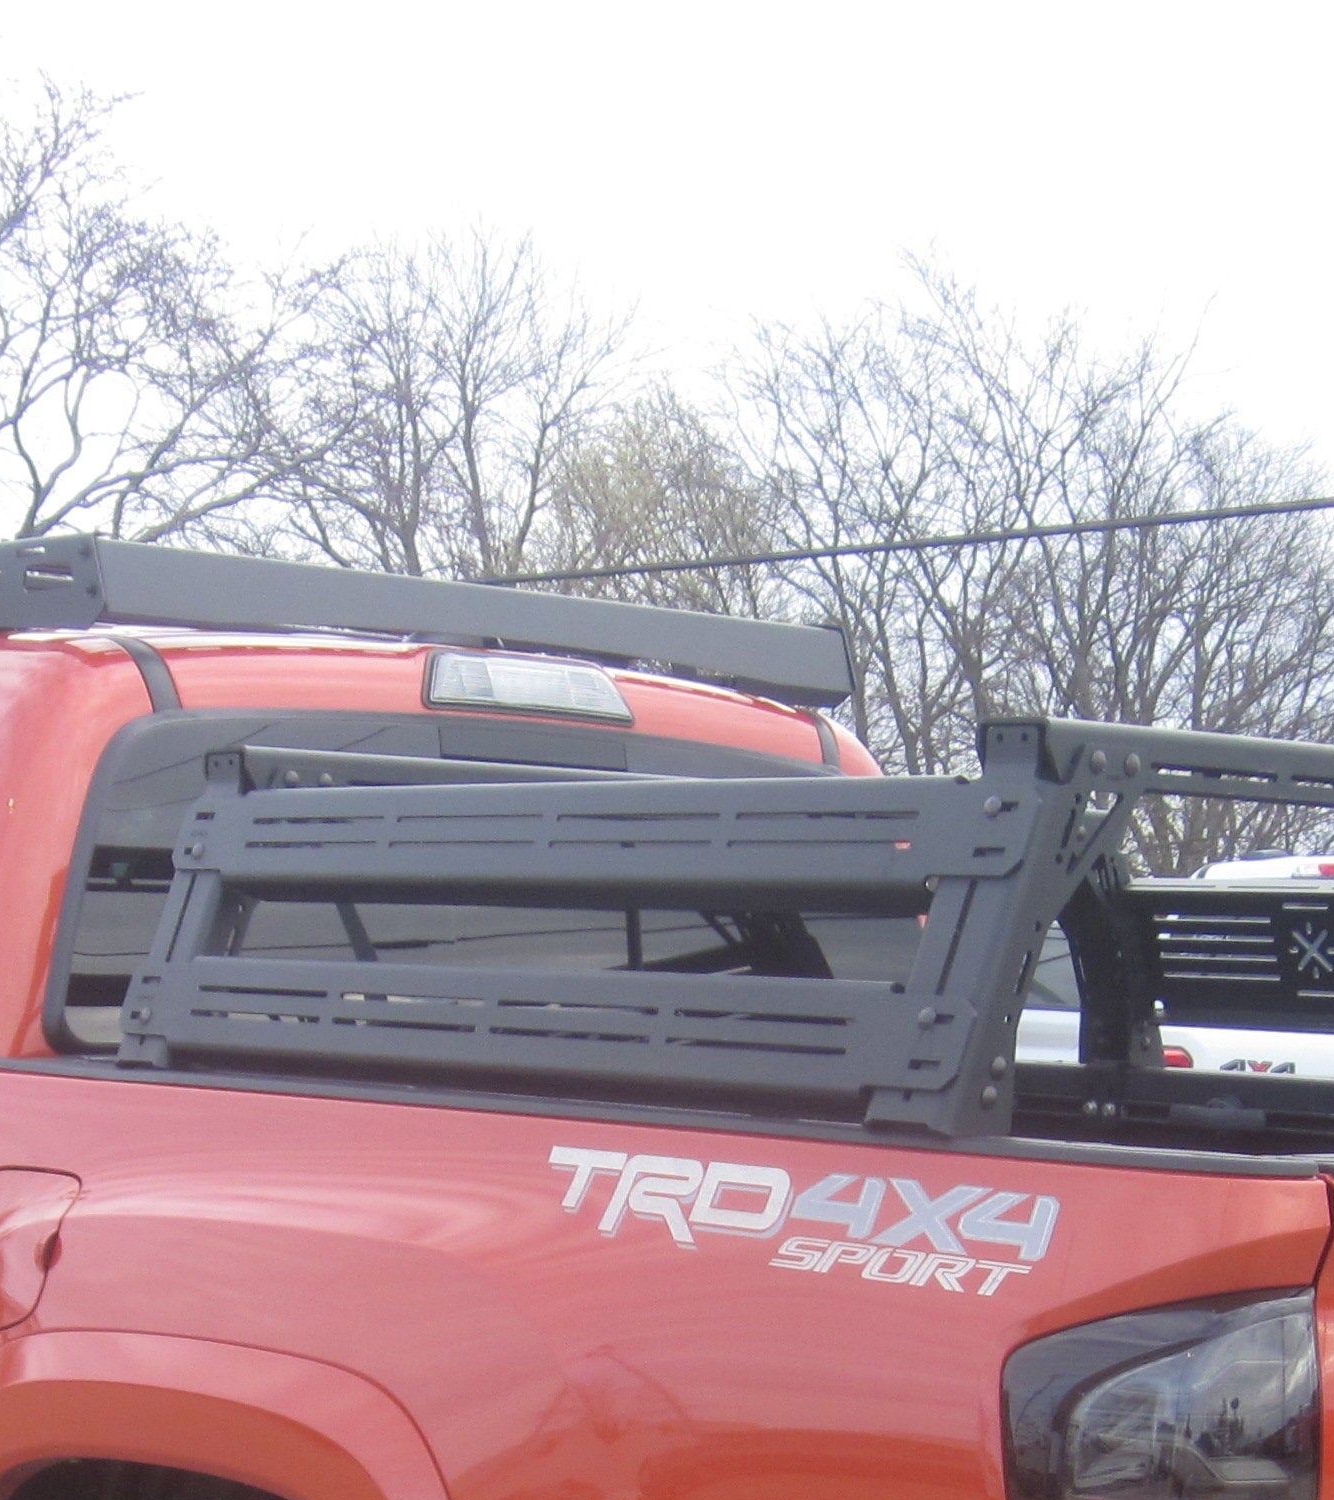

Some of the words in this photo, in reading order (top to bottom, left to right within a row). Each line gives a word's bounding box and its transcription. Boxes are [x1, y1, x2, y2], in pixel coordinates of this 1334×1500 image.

[548, 1145, 792, 1249] TRD
[790, 1173, 1061, 1261] 4X4
[769, 1236, 1032, 1296] SPORT
